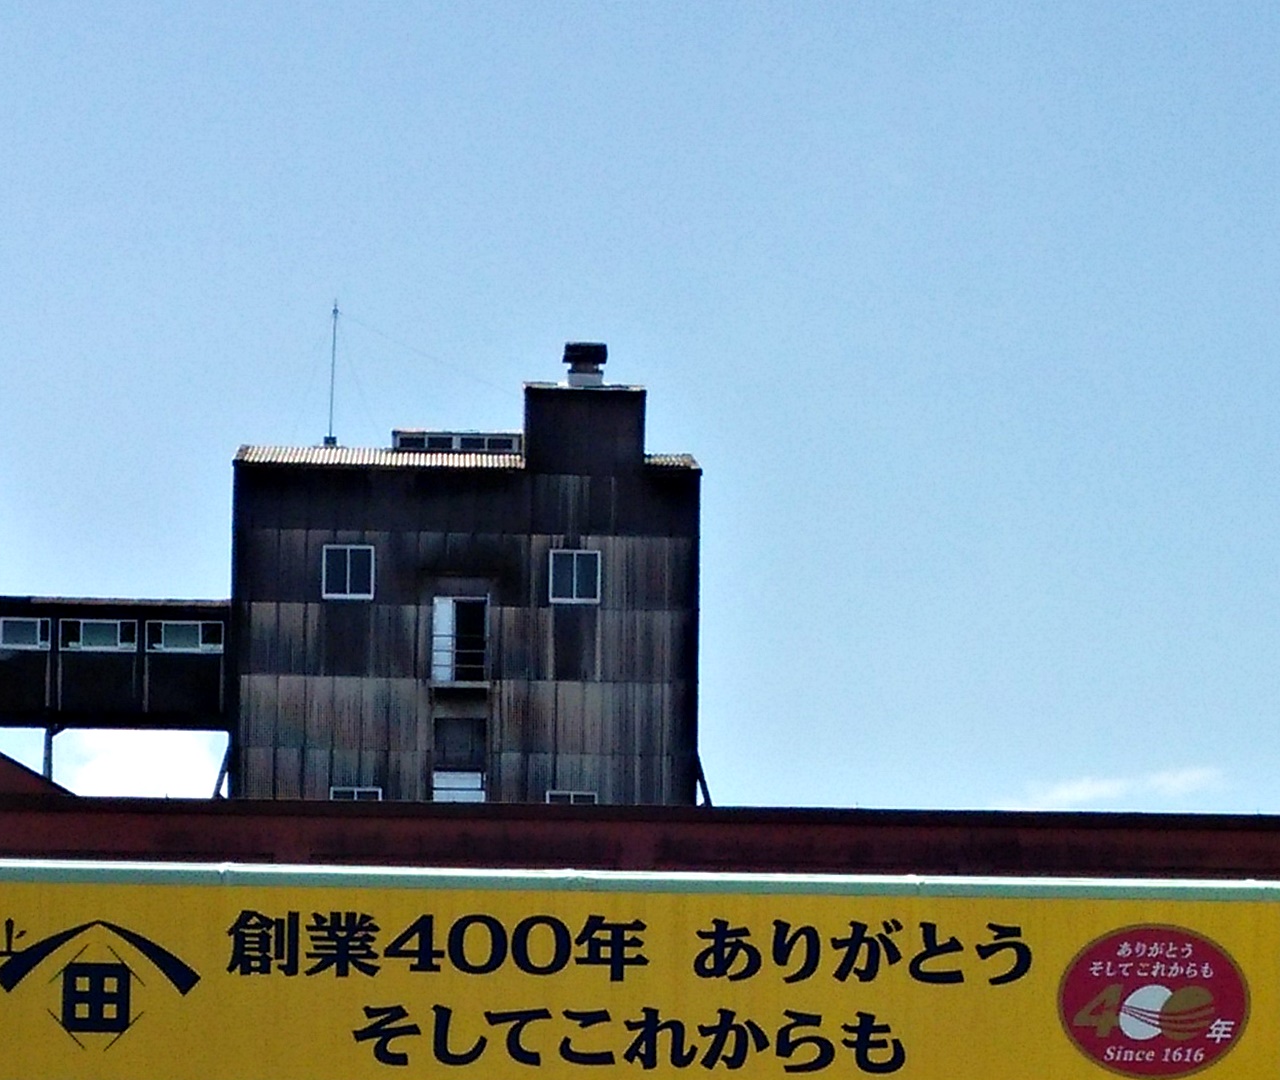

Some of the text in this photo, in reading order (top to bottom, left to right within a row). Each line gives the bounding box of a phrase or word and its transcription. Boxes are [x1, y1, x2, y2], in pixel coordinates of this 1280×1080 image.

[226, 909, 1033, 986] 創業400年 ありがとう
[1116, 942, 1193, 959] ありがとう
[352, 1003, 906, 1075] そしてこれからも
[1103, 1046, 1205, 1063] Since 1616
